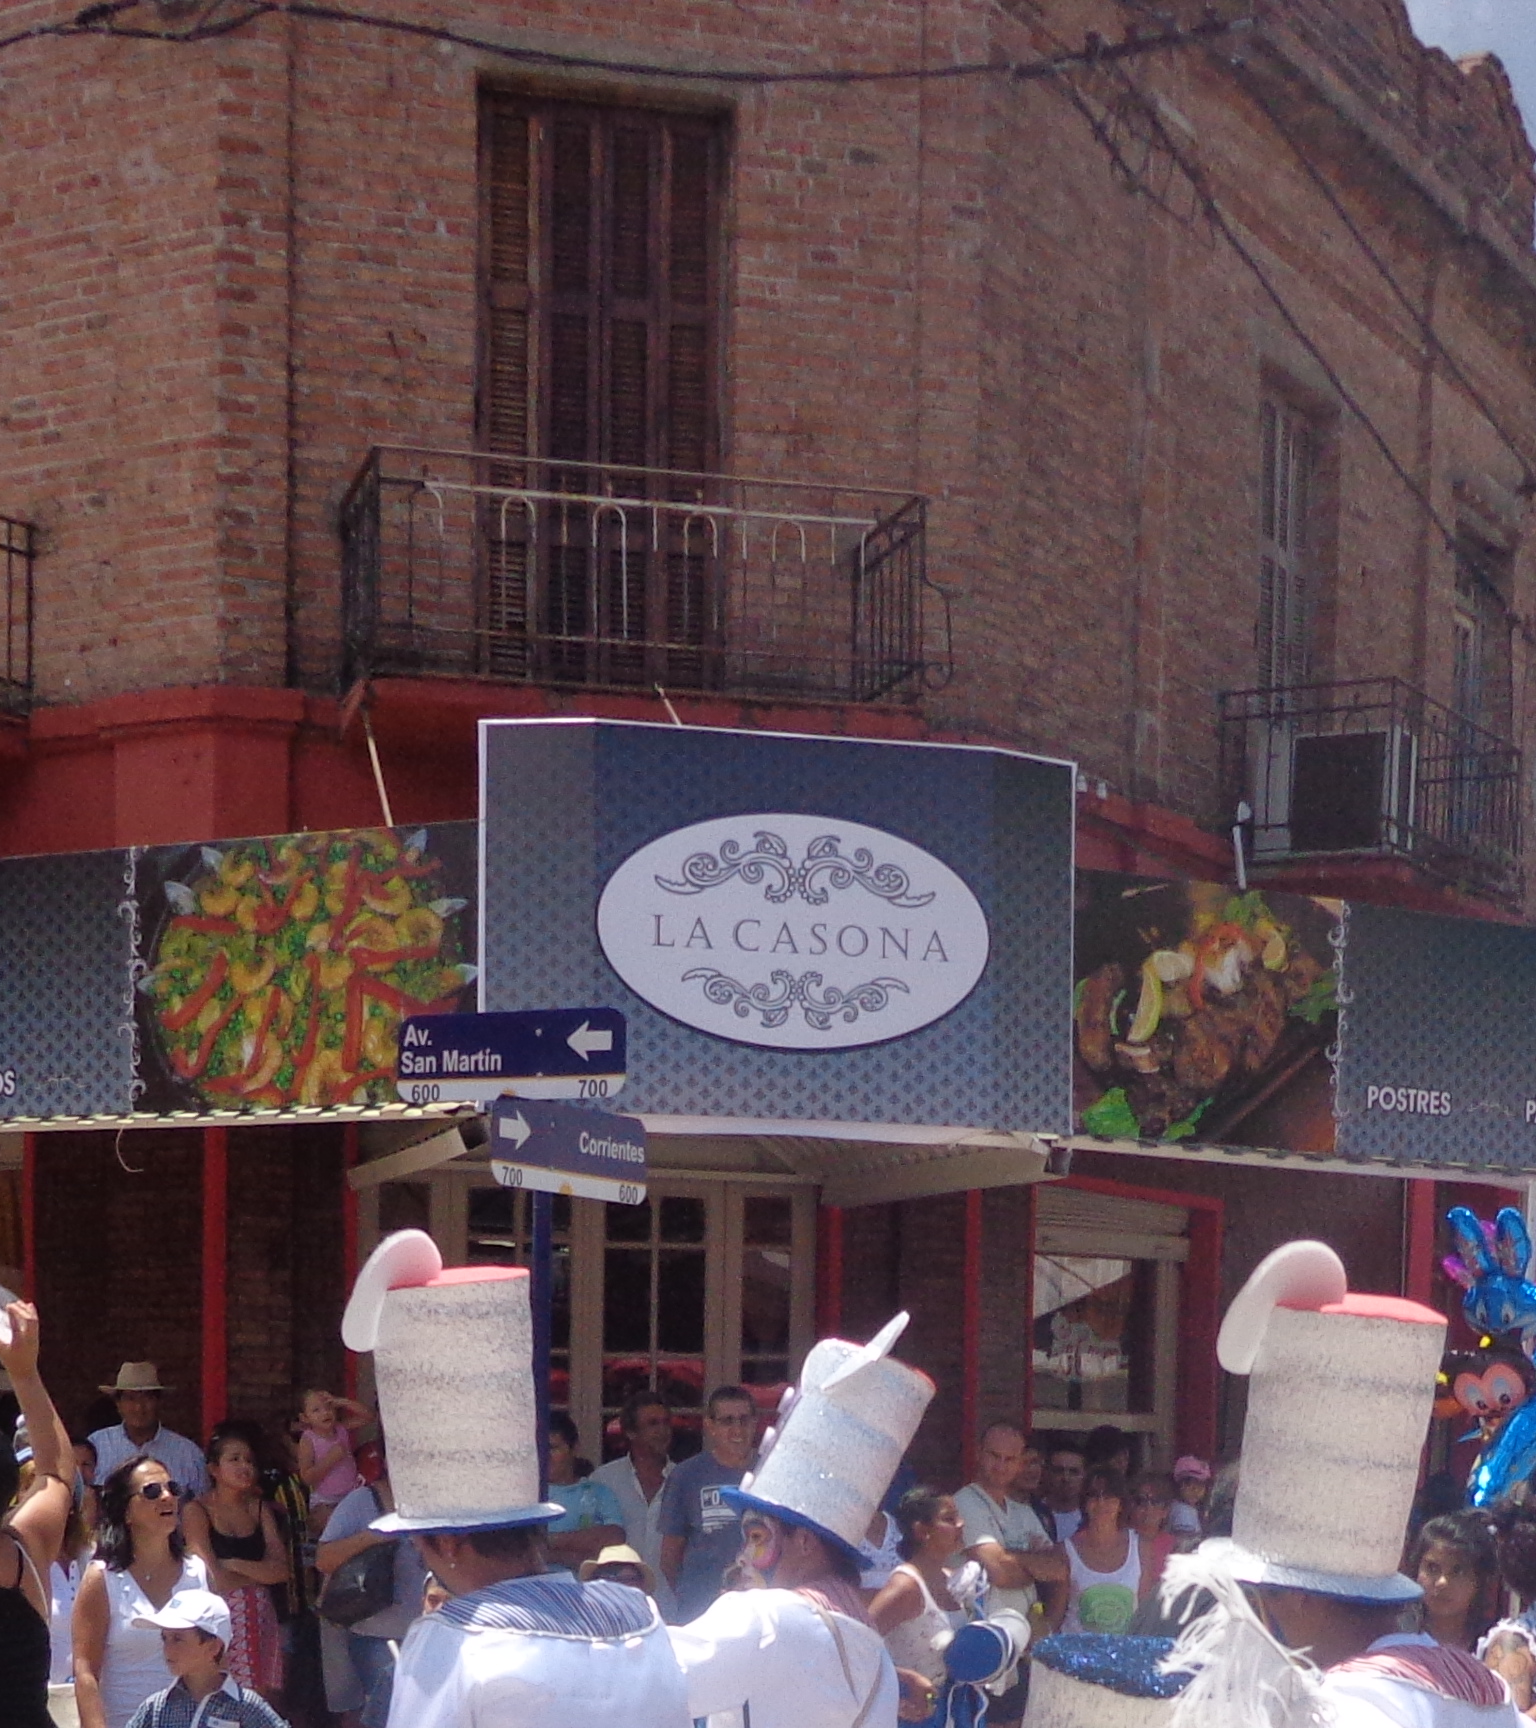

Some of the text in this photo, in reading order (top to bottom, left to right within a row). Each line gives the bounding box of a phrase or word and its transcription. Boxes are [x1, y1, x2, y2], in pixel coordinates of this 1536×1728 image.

[652, 914, 949, 962] LA CASONA
[403, 1024, 432, 1047] Av.
[401, 1048, 503, 1074] San Martín
[411, 1083, 441, 1102] 600
[578, 1079, 608, 1098] 700
[1367, 1085, 1451, 1116] POSTRES
[579, 1131, 645, 1164] Corrientes
[502, 1166, 523, 1187] 700
[619, 1184, 638, 1203] 600
